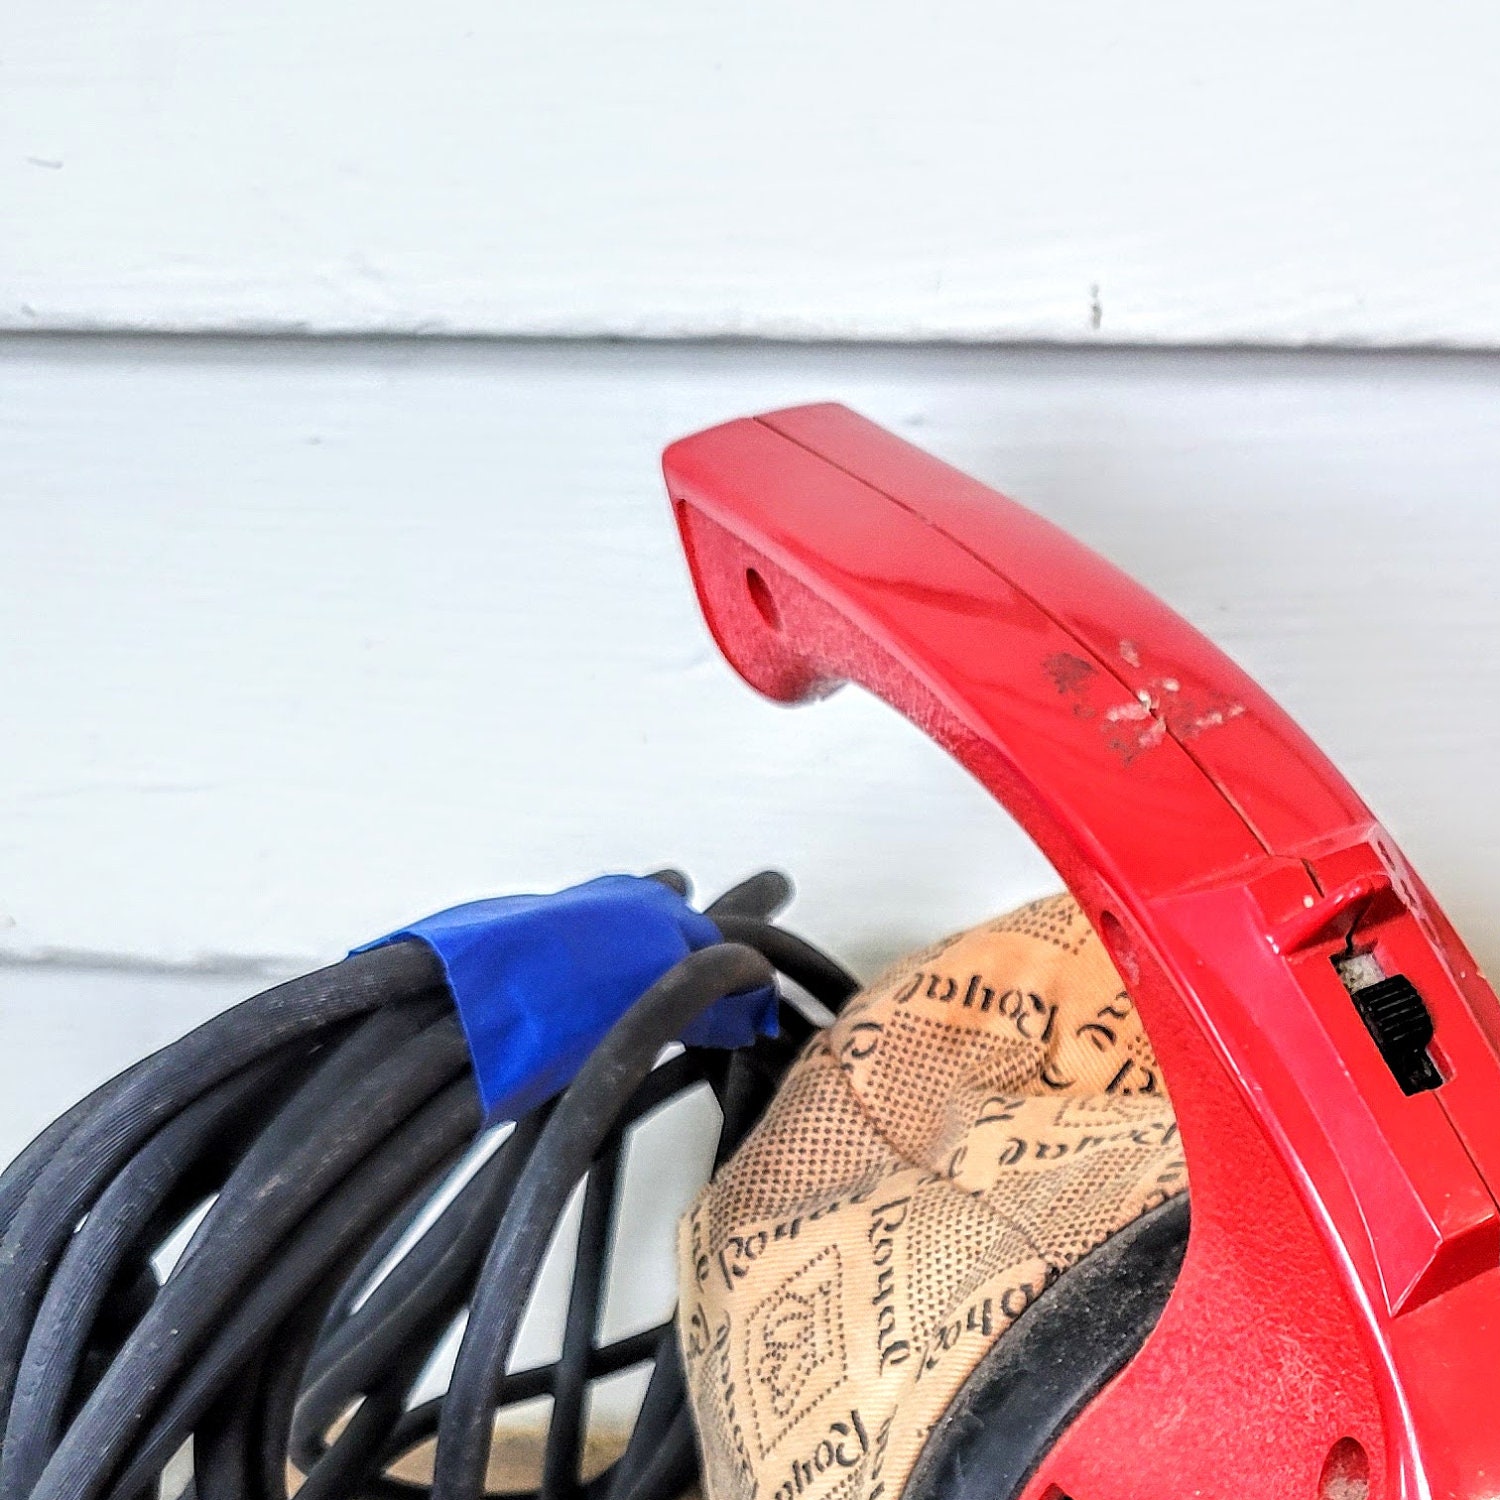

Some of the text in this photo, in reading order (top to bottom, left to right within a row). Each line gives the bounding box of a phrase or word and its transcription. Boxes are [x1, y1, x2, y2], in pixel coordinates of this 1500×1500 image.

[893, 970, 1059, 1045] Royal
[871, 1196, 911, 1376] Royal
[915, 1279, 1040, 1381] Roya
